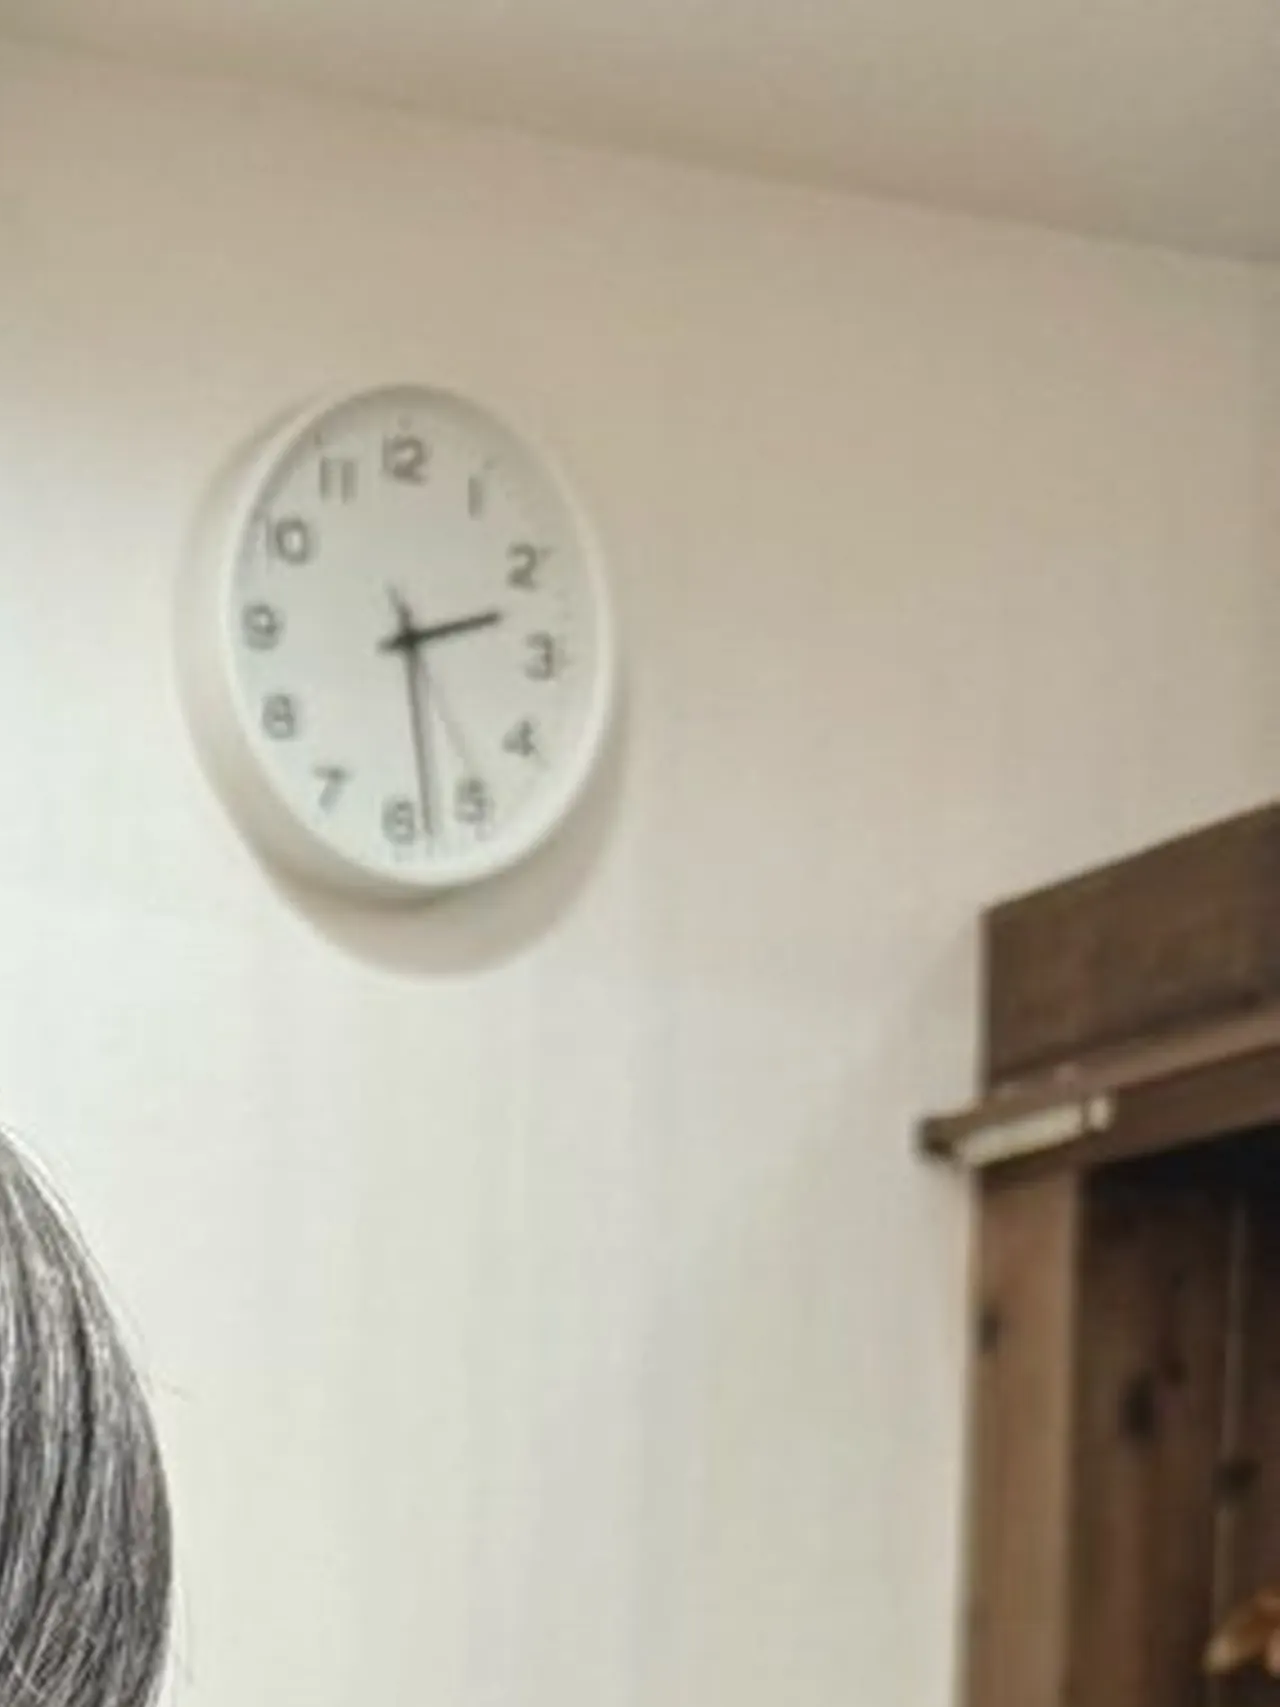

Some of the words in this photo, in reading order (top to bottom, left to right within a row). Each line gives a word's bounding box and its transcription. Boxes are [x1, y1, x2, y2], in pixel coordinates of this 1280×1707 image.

[318, 457, 359, 506] 11
[381, 436, 431, 484] 12
[466, 474, 487, 518] 1
[506, 544, 541, 589] 2
[242, 604, 280, 650] 9
[523, 634, 556, 682] 3
[262, 694, 297, 740] 8
[504, 722, 540, 758] 4
[311, 765, 348, 811] 7
[454, 779, 489, 824] 5
[382, 801, 417, 846] 6
